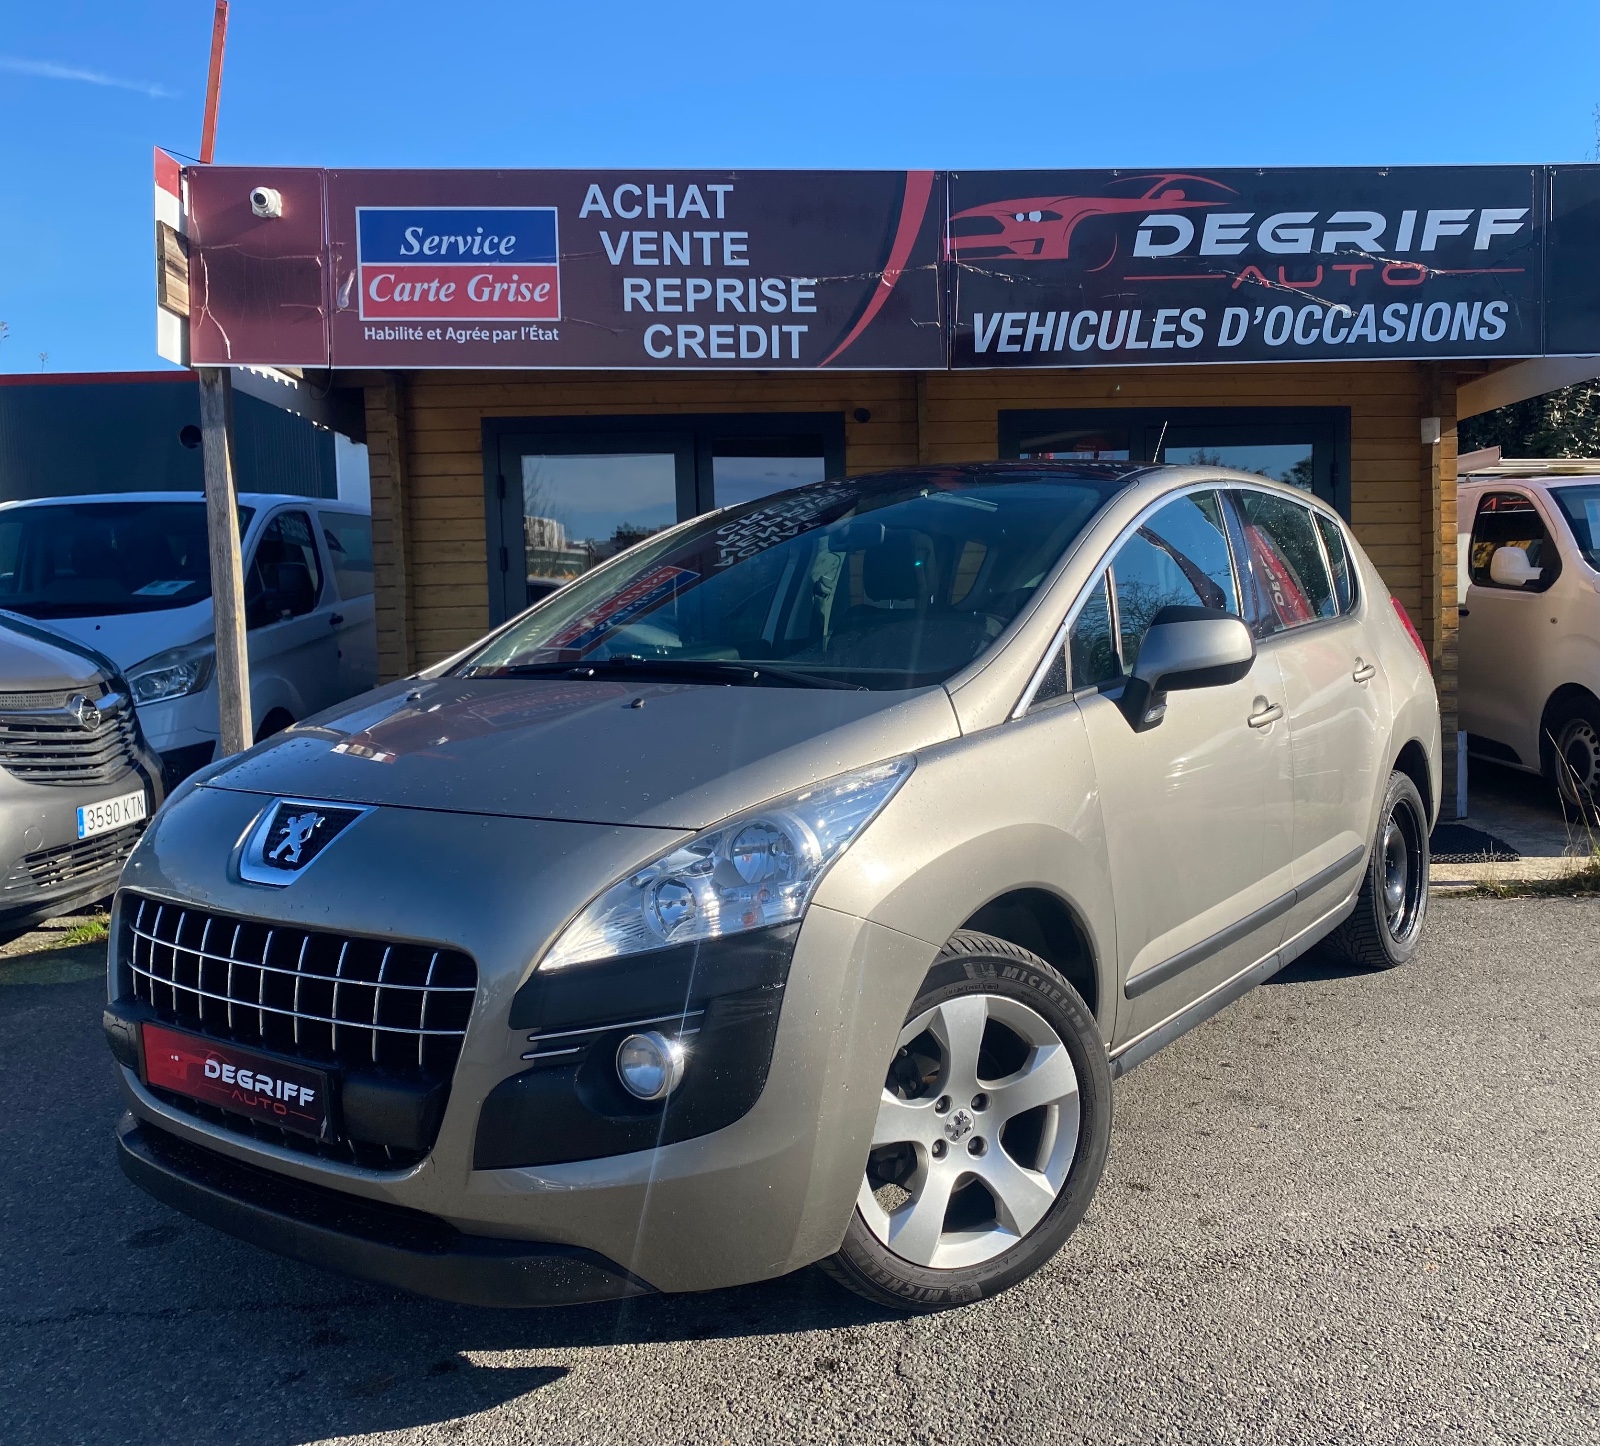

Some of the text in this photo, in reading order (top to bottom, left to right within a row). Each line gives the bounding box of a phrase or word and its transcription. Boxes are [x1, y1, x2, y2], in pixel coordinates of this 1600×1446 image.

[579, 183, 734, 219] ACHAT
[400, 226, 516, 256] Service
[599, 231, 750, 266] VENTE
[1133, 207, 1531, 257] DEGRIFF
[368, 274, 551, 303] Carte Grise
[1232, 263, 1427, 290] AUTO
[623, 278, 817, 313] REPRISE
[364, 326, 423, 341] Habilité
[427, 329, 443, 341] et
[446, 326, 490, 344] Agrée
[493, 330, 517, 344] par
[643, 324, 808, 359] CREDIT
[974, 300, 1509, 354] VEHICULES D'OCCASIONS
[87, 794, 144, 831] 3590 KTN
[1002, 965, 1086, 1032] MICHELIN
[204, 1058, 316, 1107] DEGRIFF
[231, 1089, 287, 1116] AUTO
